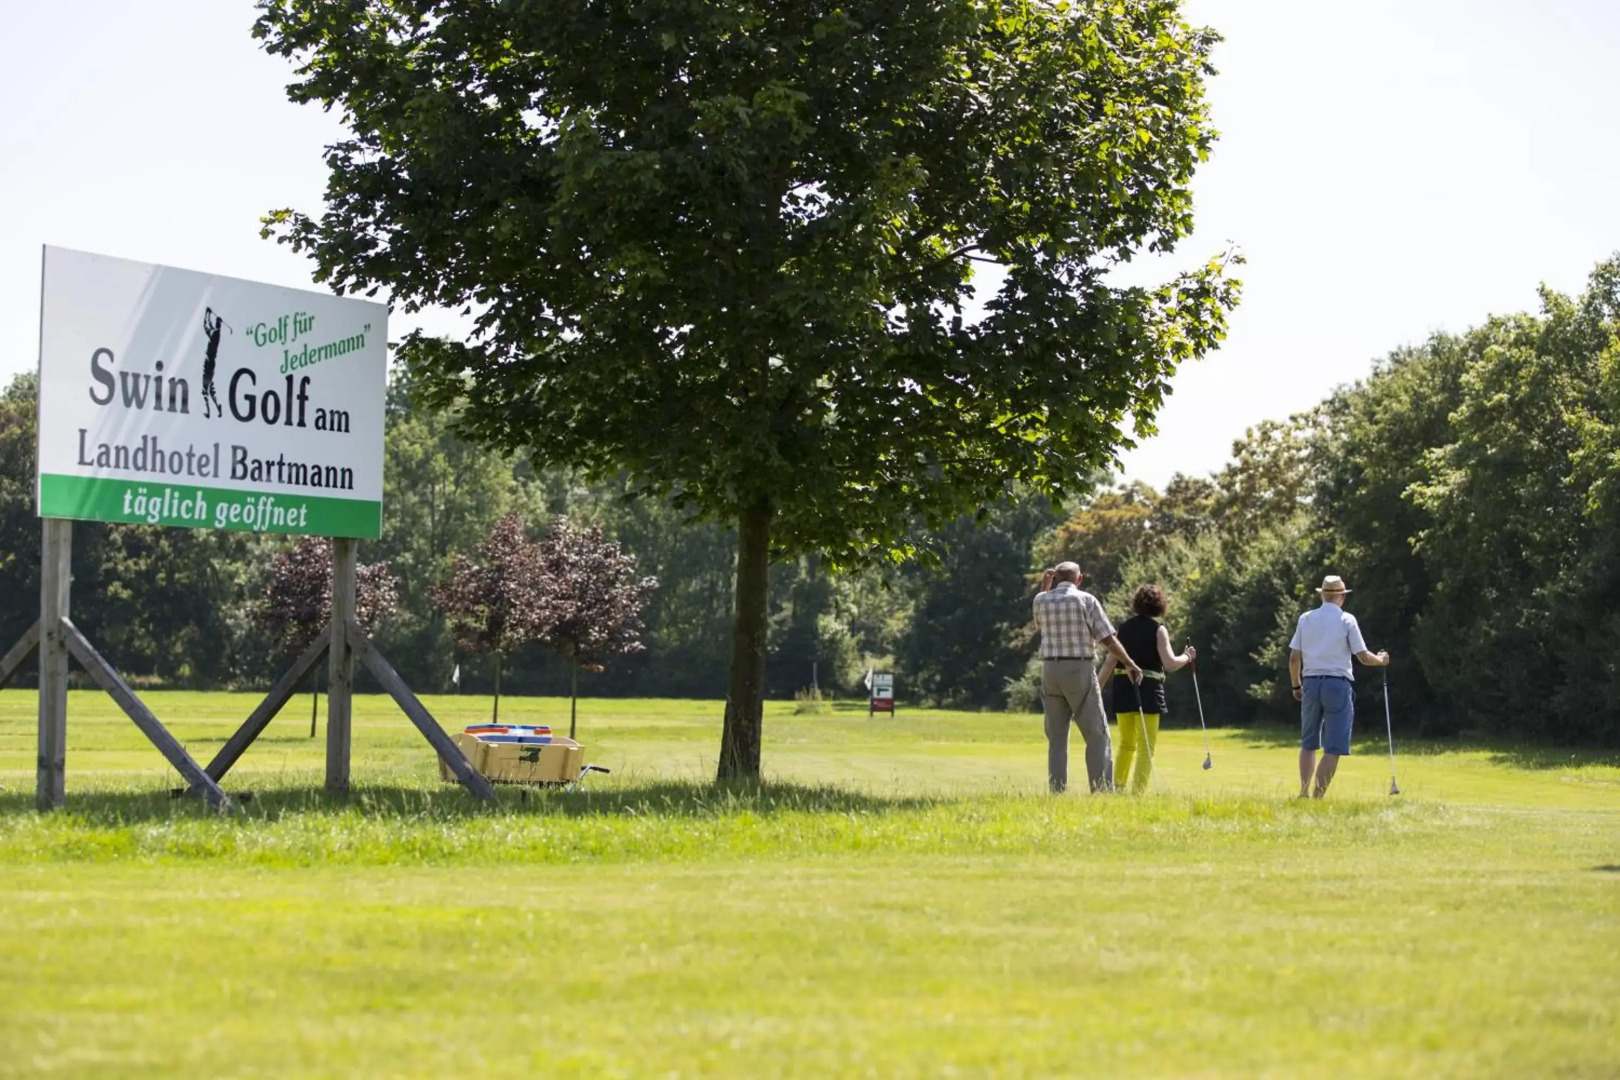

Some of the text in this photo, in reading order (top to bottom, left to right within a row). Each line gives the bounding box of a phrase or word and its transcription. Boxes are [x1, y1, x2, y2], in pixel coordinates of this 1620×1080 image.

[291, 312, 316, 342] für
[89, 347, 350, 433] Swin Golf am
[77, 428, 354, 490] Landhotel Bartmann
[122, 488, 308, 531] täglich geöffnet
